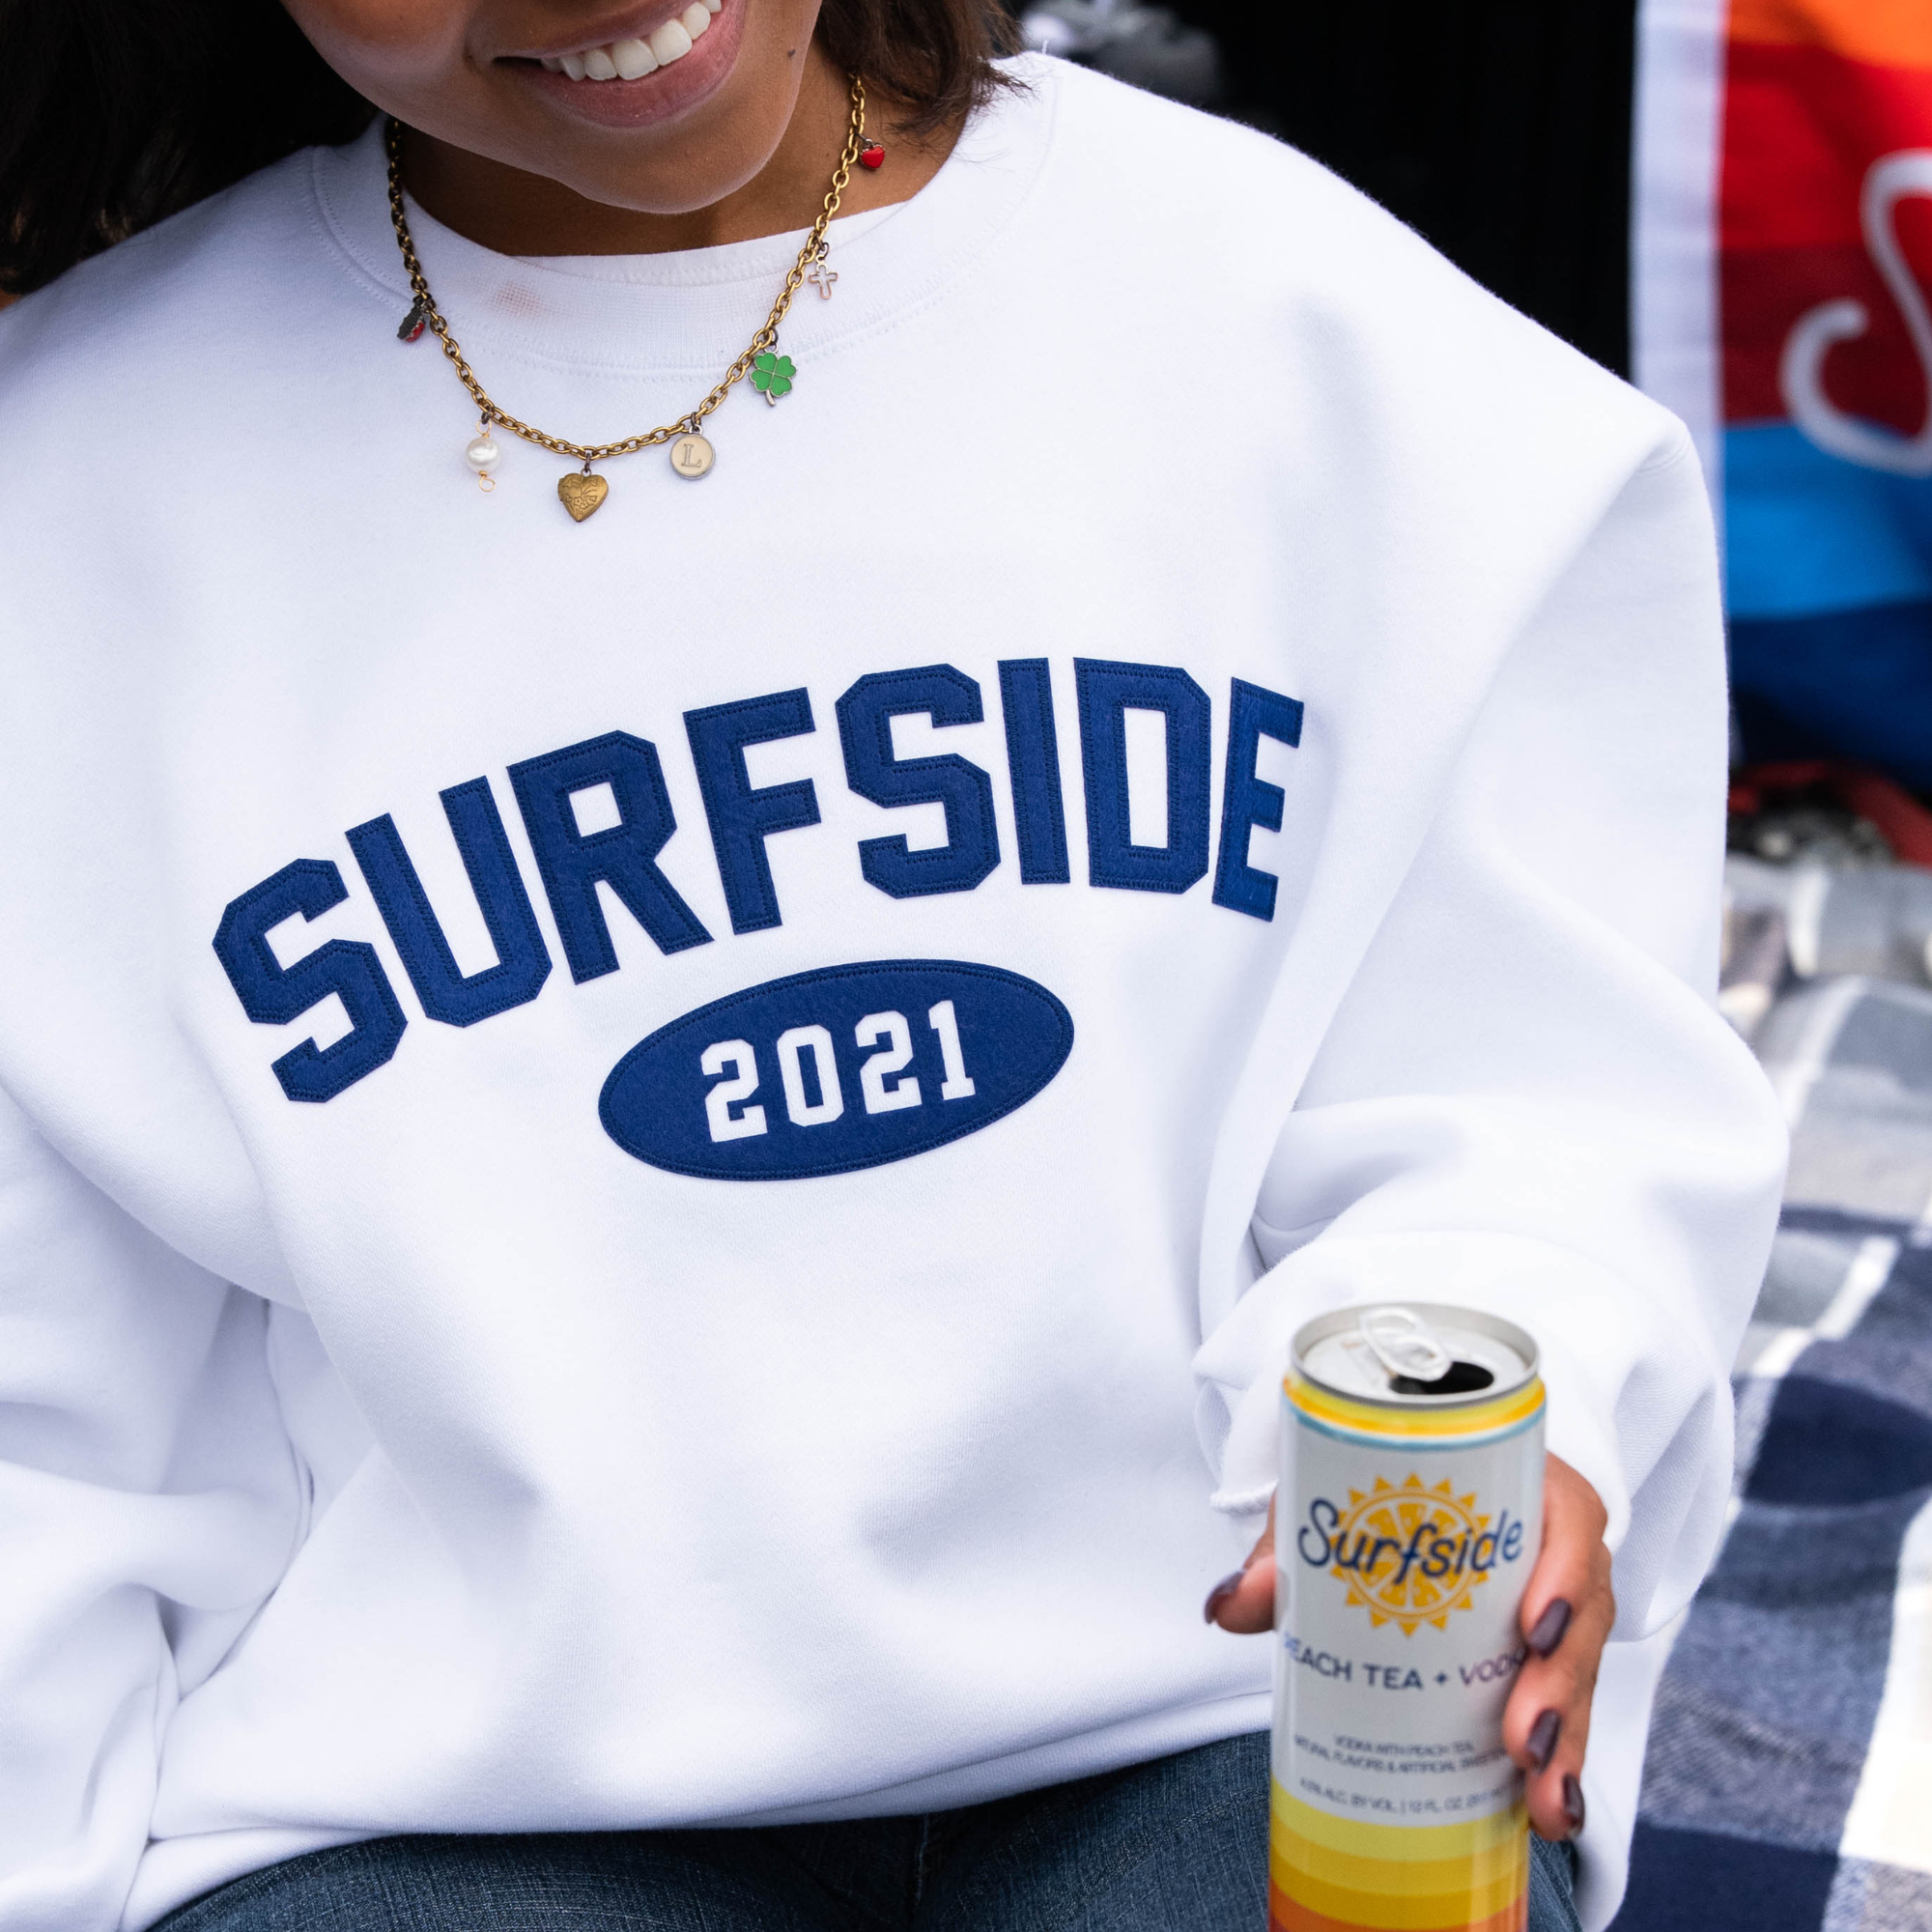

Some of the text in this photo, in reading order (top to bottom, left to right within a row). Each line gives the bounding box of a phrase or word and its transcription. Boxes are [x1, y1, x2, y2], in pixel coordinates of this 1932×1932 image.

[681, 442, 703, 468] L
[212, 657, 1305, 1104] SURFSIDE
[700, 999, 977, 1144] 2021
[1297, 1497, 1523, 1584] Surfside
[1361, 1661, 1425, 1690] TEA
